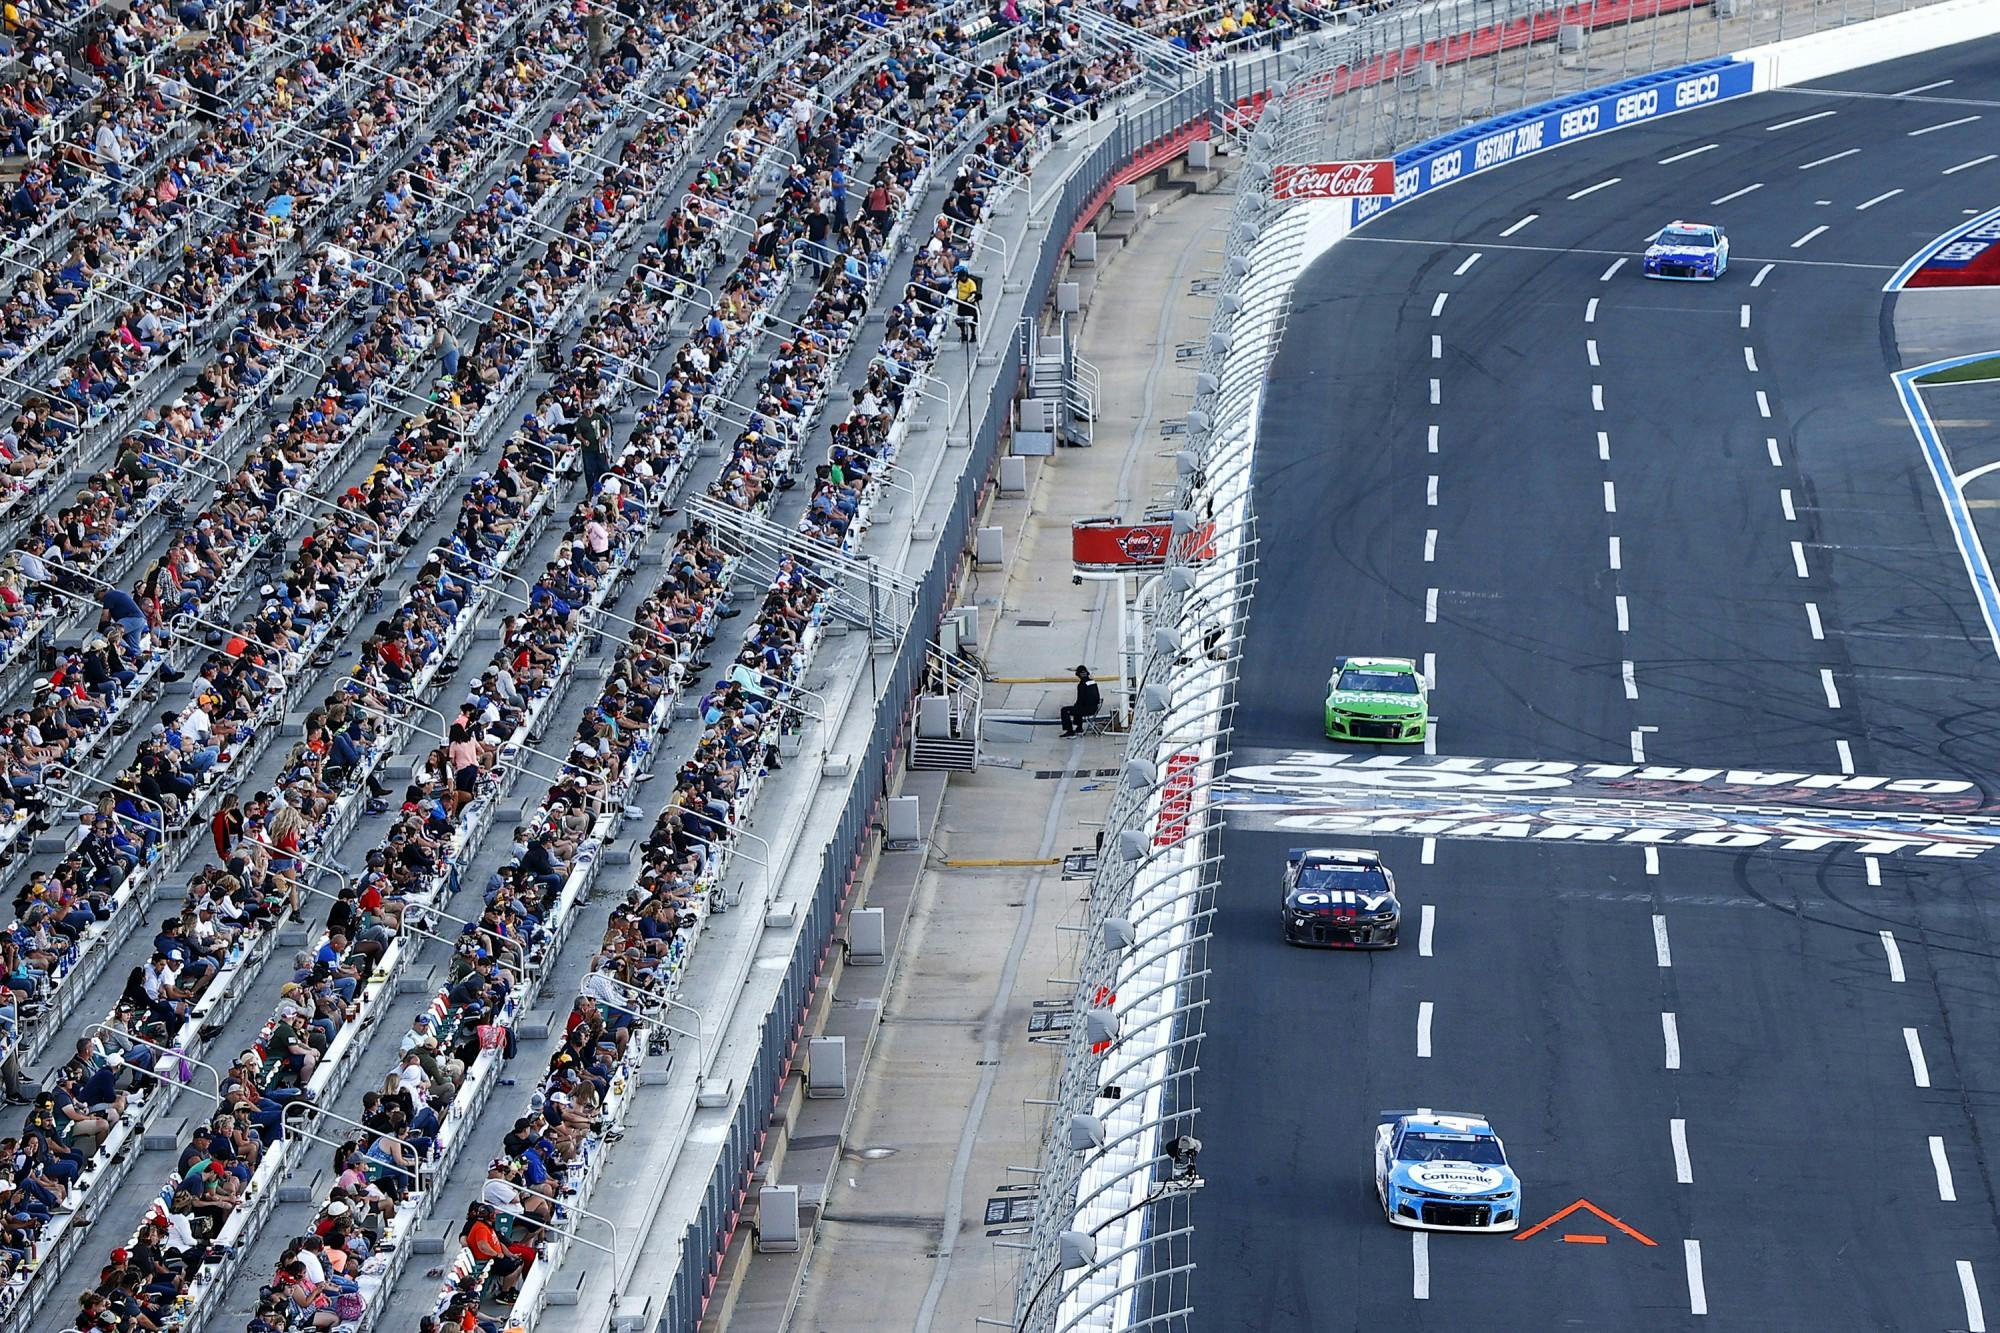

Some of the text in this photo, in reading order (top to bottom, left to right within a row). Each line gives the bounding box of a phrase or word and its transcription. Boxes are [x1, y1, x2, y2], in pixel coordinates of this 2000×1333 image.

[1615, 89, 1659, 123] GEICO
[1675, 73, 1720, 107] GEICO
[1559, 104, 1600, 139] GEICO
[1473, 120, 1546, 170] RESTART ZONE
[1287, 163, 1378, 197] Coca-Cola
[1430, 149, 1462, 184] GEICO
[1334, 696, 1419, 708] UNIFORMS
[1226, 764, 1574, 792] 600
[1275, 751, 1975, 793] CHARLOTTE
[1274, 814, 1996, 859] CHARLOTTE
[1296, 890, 1388, 911] ally
[1420, 1171, 1494, 1185] Cottonelle
